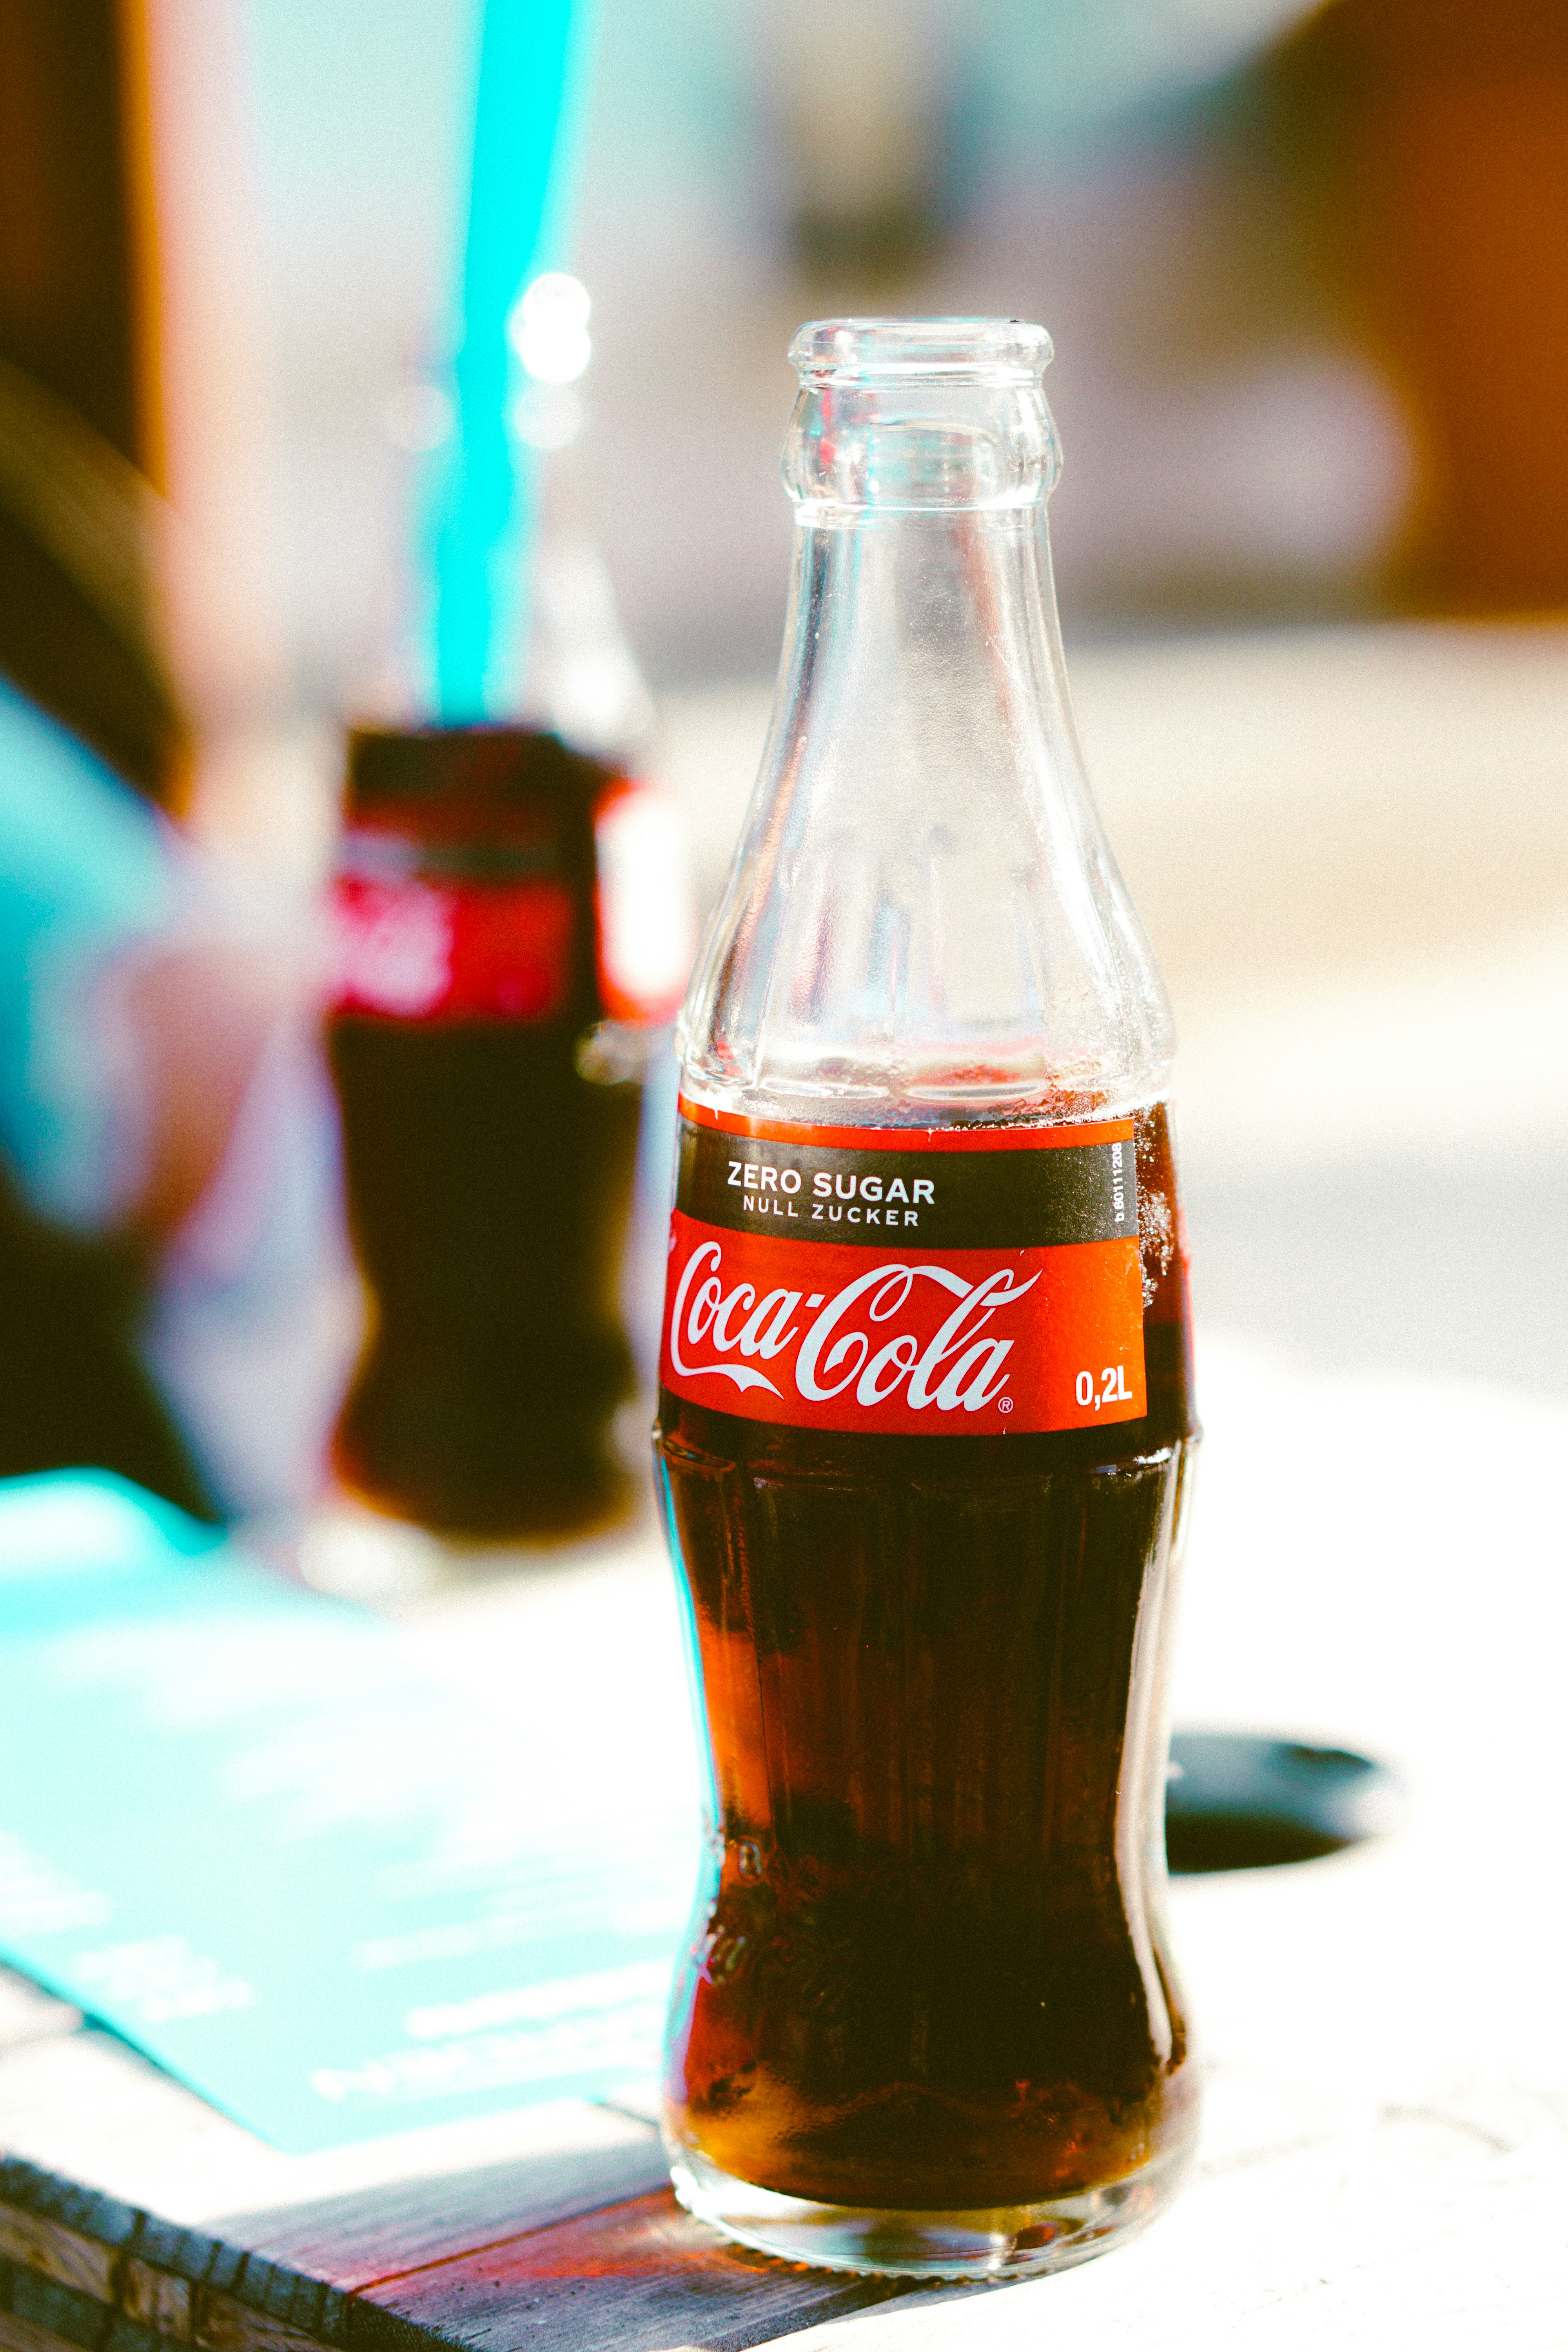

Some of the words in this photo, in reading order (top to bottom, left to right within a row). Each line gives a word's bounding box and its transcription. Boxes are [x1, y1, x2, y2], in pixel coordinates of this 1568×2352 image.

[728, 1160, 802, 1194] ZERO
[813, 1172, 935, 1205] SUGAR
[1111, 1142, 1125, 1210] 60111208
[743, 1194, 799, 1218] NULL
[811, 1203, 918, 1227] ZUCKER
[1114, 1212, 1125, 1222] b
[671, 1241, 1043, 1412] Coca-Cola
[1075, 1365, 1132, 1411] 0,2L
